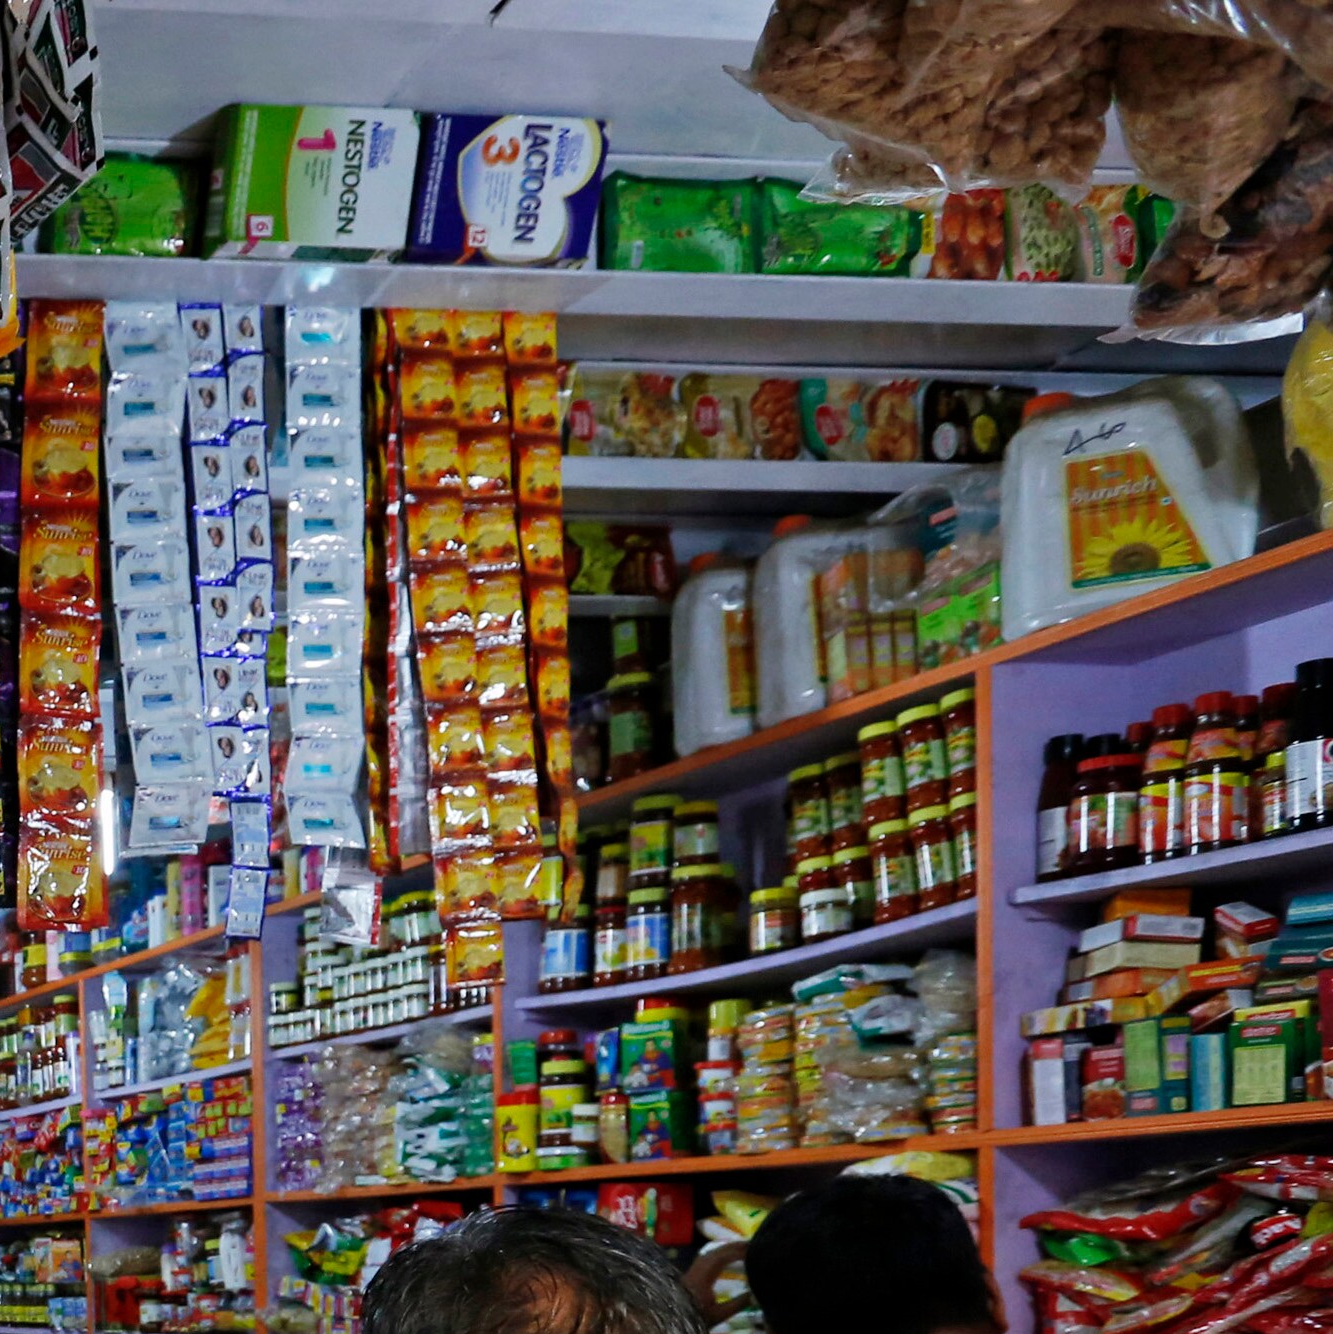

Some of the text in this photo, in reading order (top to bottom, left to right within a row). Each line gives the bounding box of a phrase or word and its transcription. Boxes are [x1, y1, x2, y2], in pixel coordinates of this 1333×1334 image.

[297, 128, 337, 151] 1
[481, 135, 521, 167] 3
[336, 119, 366, 235] NESTOGEN
[513, 123, 554, 245] LACTOGEN
[1072, 476, 1158, 503] Sunrich
